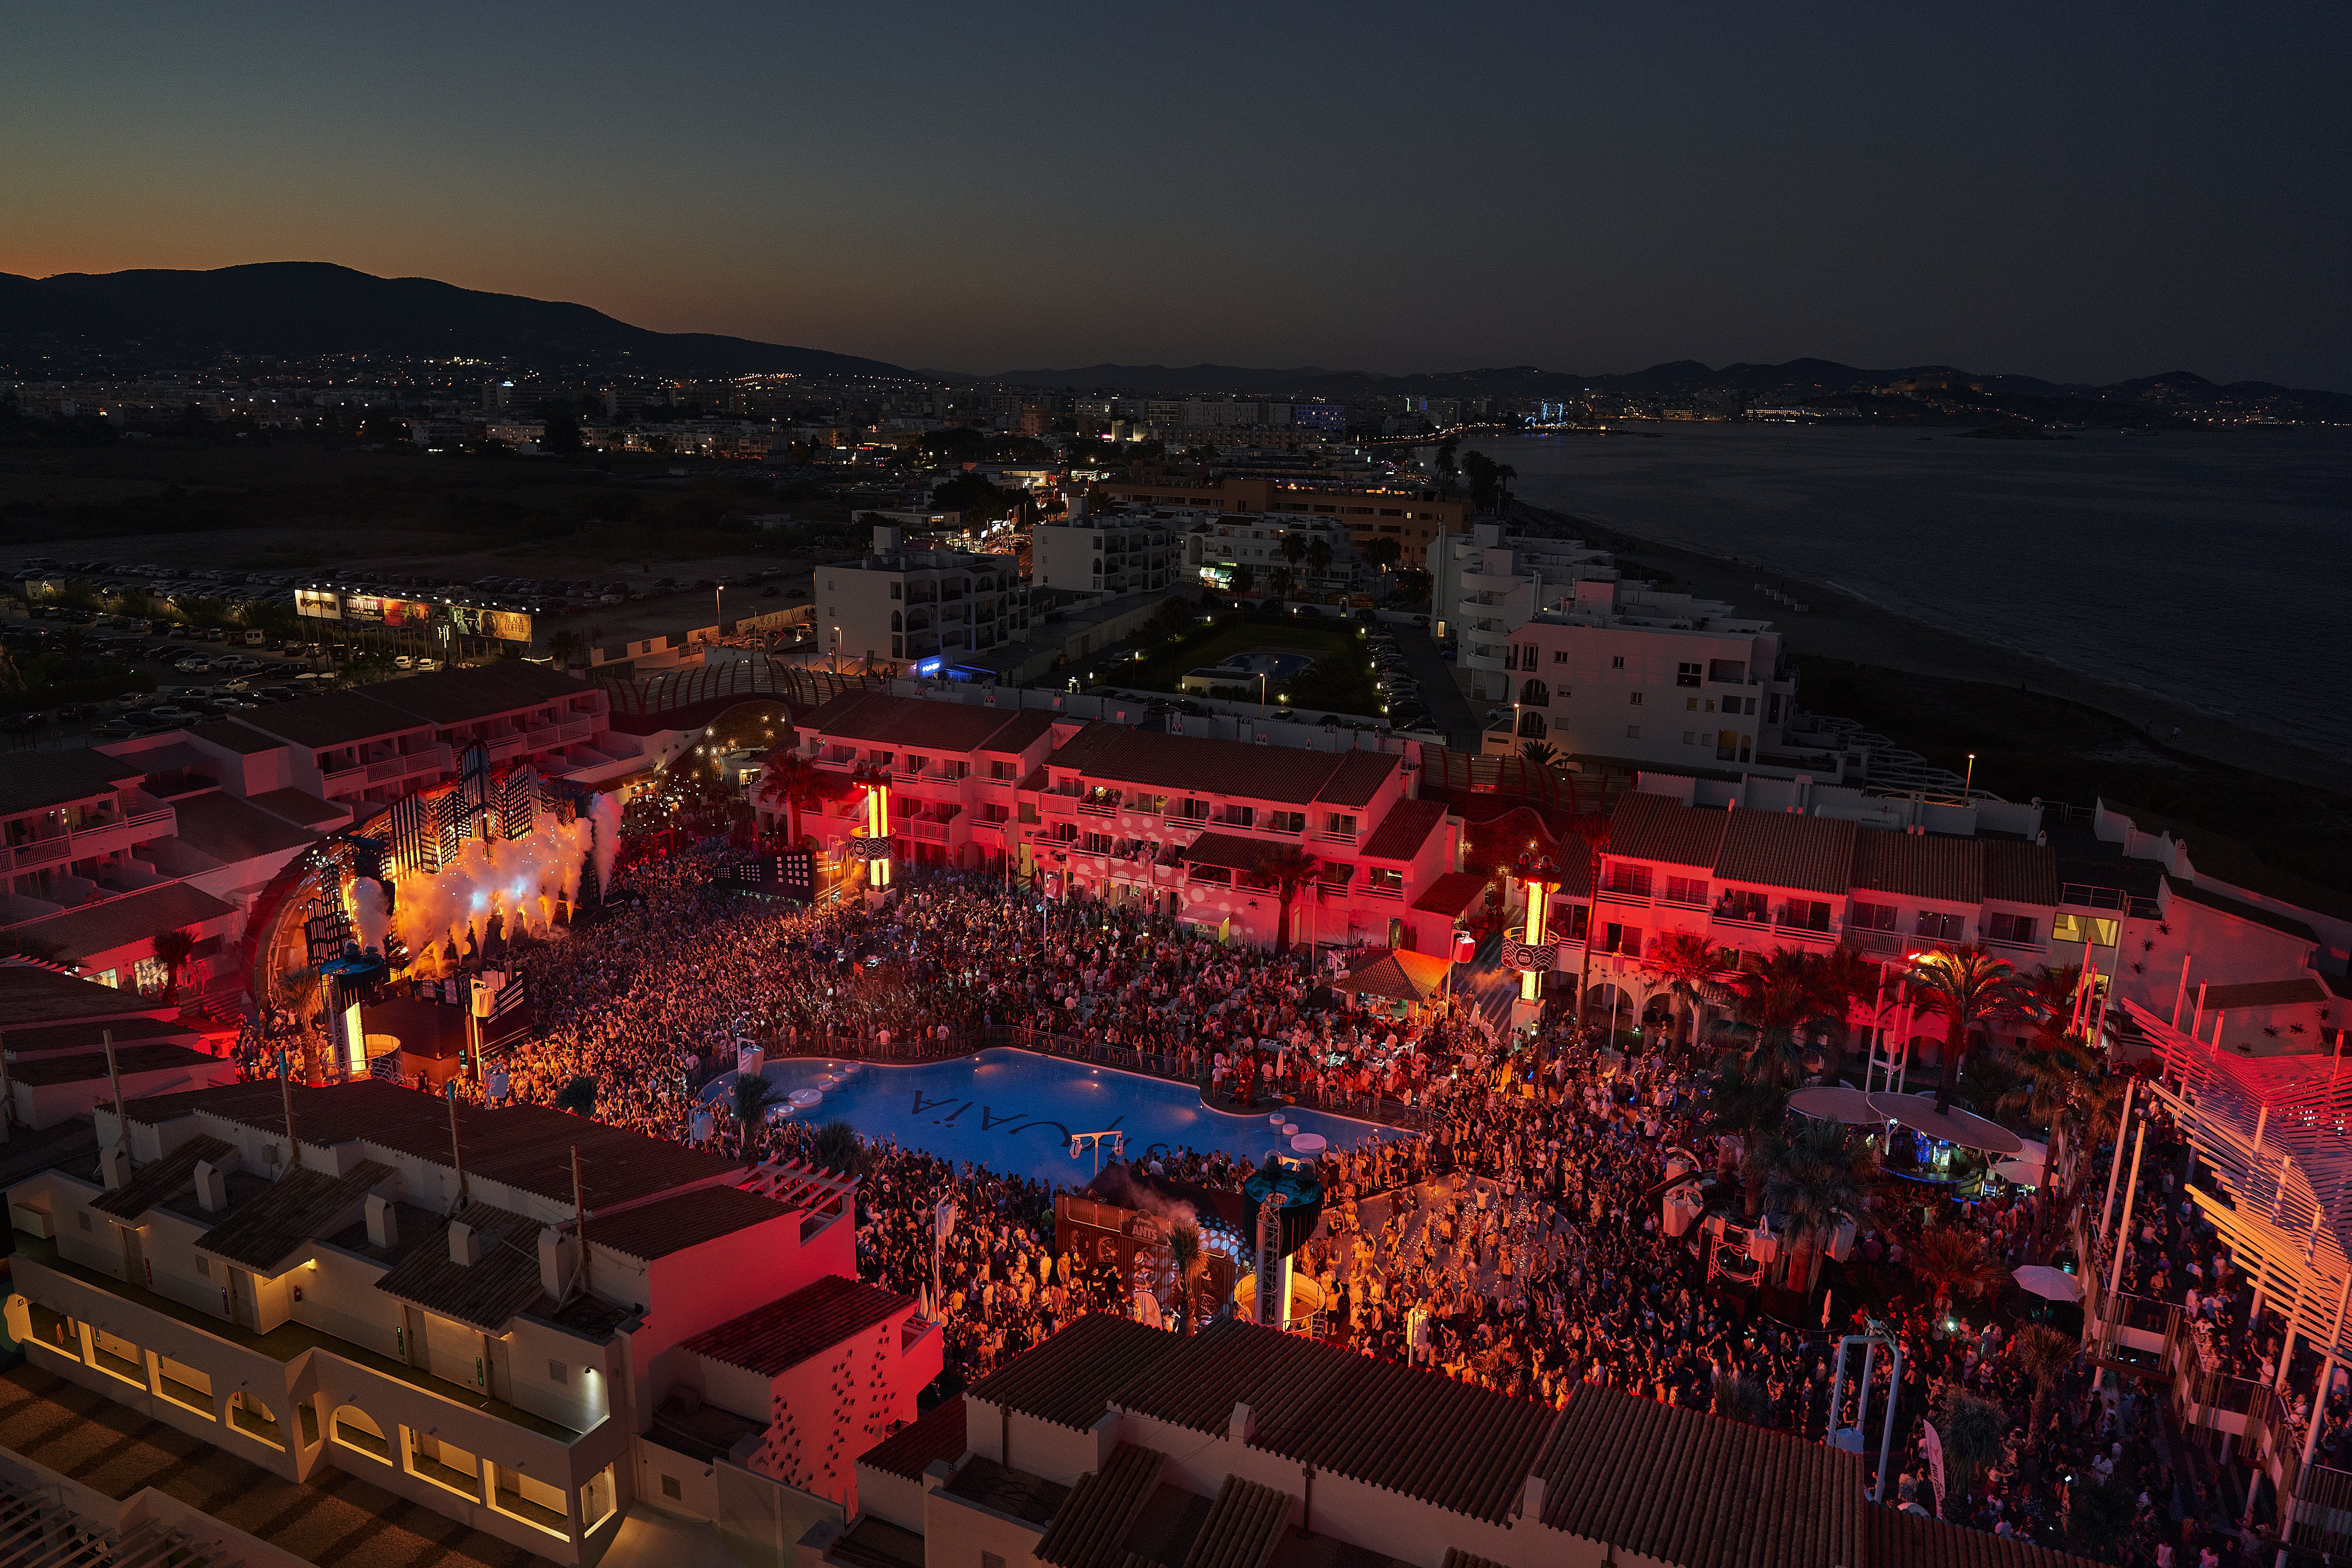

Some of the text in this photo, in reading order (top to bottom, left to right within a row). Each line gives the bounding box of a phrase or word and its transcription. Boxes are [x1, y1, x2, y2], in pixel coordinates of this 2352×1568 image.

[505, 615, 523, 624] BLACK
[505, 623, 525, 633] COFFEE
[1132, 1225, 1157, 1240] ANTS
